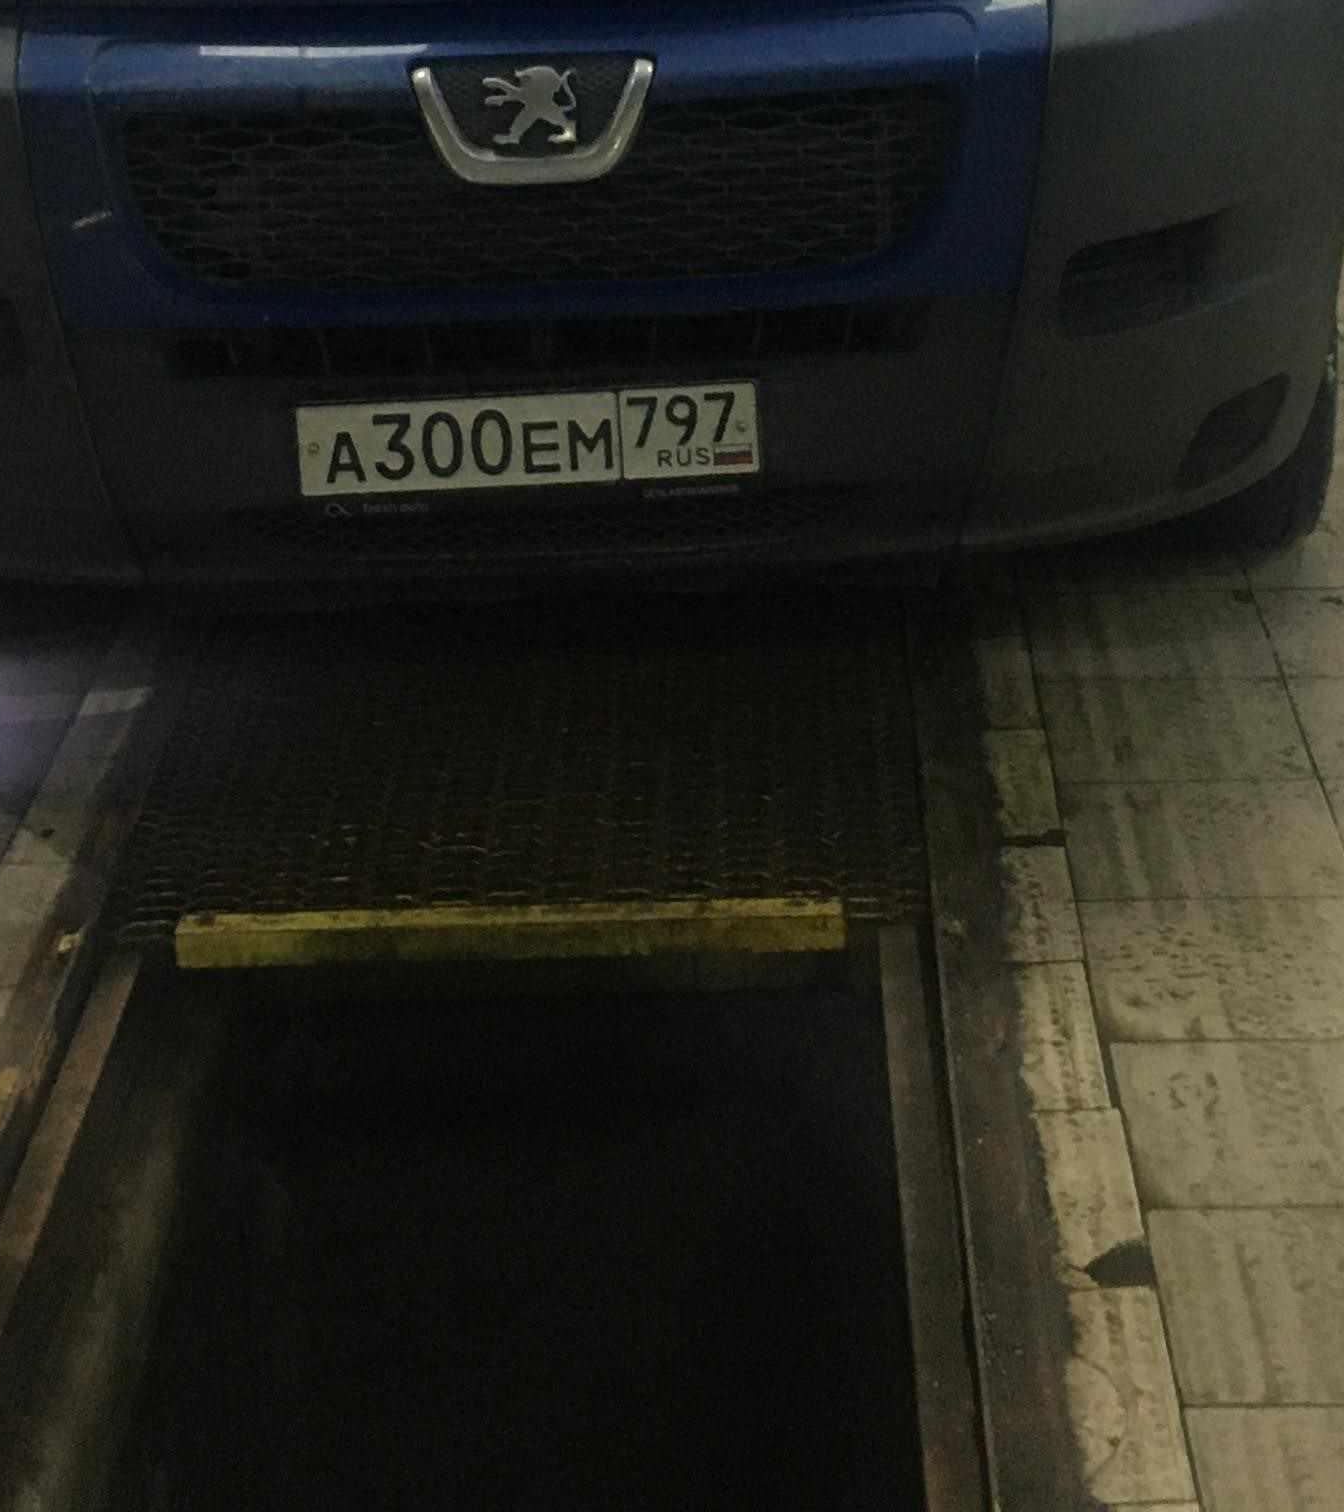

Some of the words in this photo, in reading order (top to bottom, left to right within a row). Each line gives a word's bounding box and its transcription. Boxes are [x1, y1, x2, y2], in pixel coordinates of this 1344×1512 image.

[325, 408, 616, 485] А300ЕМ
[626, 391, 736, 449] 797
[656, 447, 712, 468] RUS
